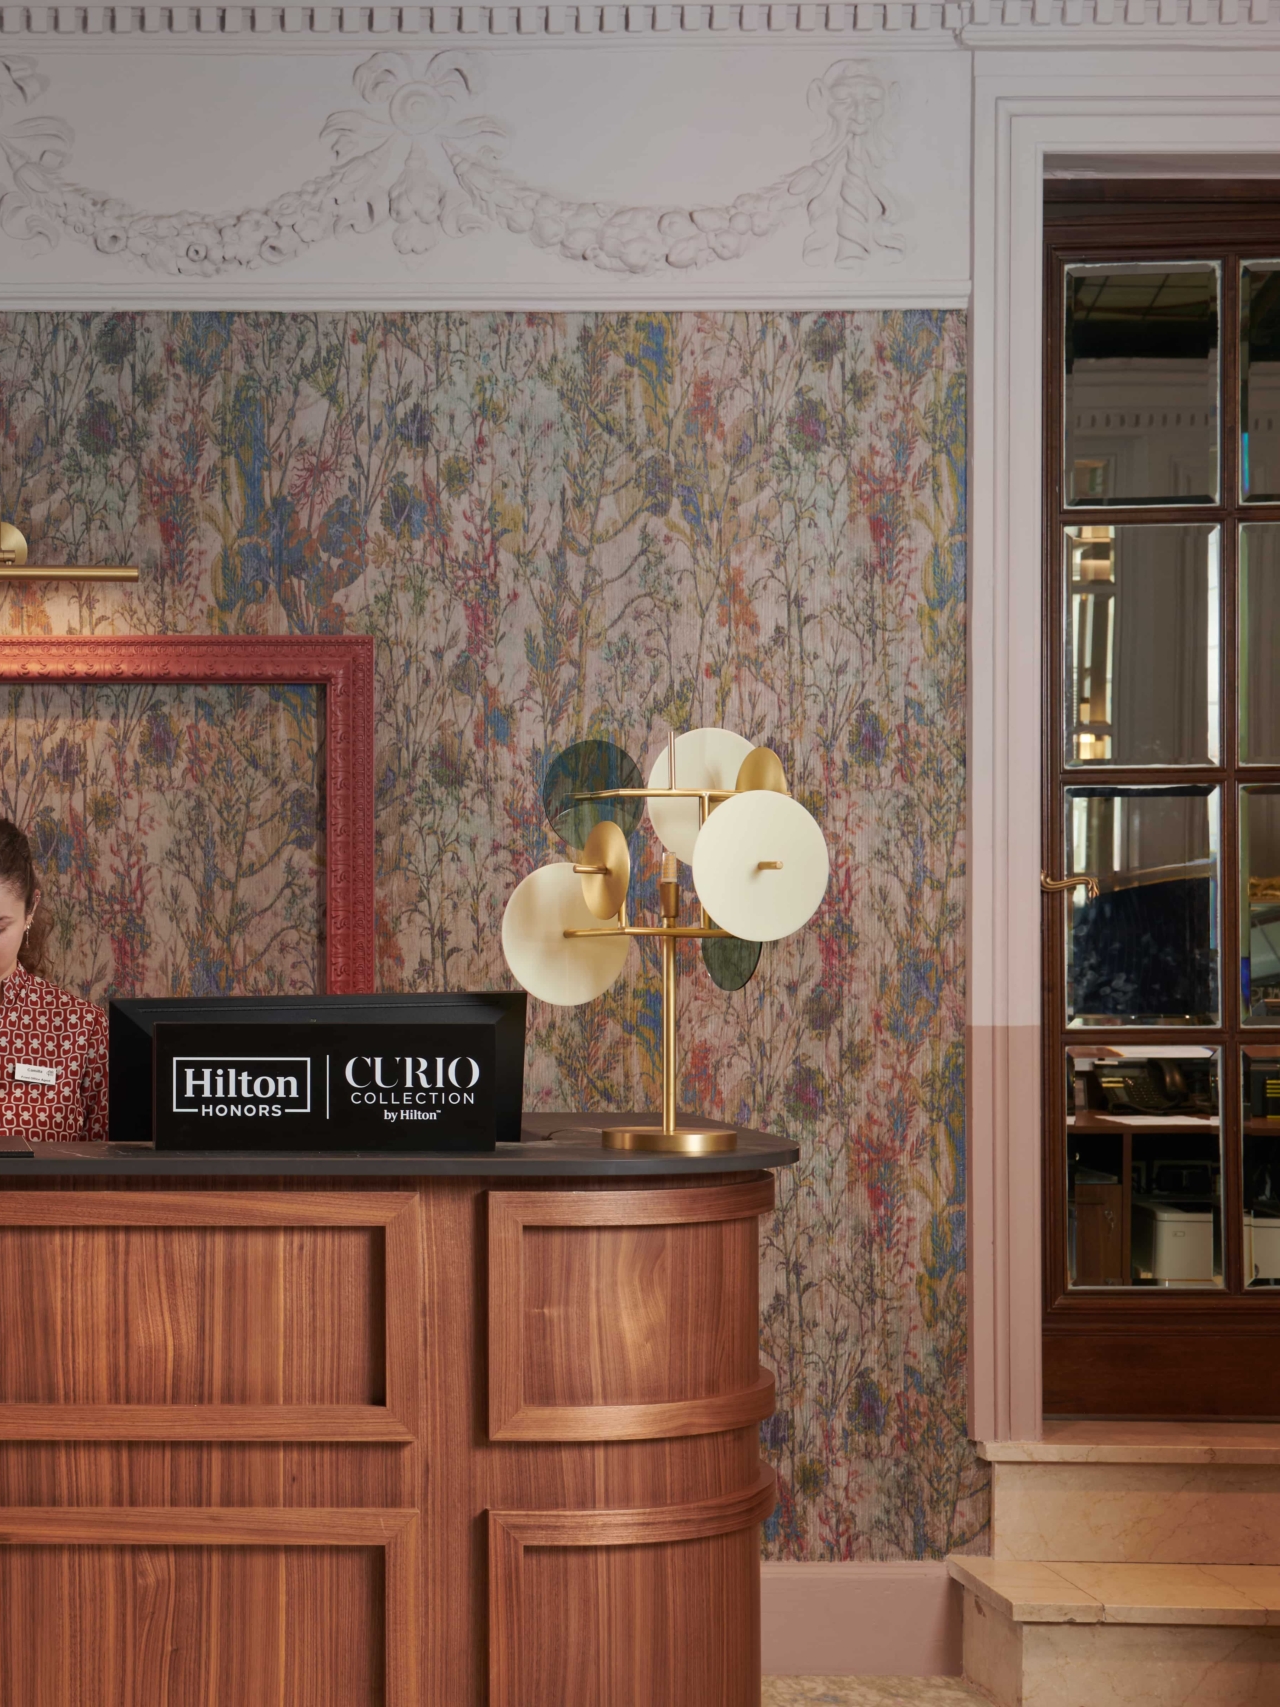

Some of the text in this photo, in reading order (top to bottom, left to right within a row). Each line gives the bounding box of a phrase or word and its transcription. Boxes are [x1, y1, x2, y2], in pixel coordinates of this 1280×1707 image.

[345, 1057, 480, 1089] CURIO
[184, 1068, 300, 1098] Hilton
[351, 1092, 475, 1105] COLLECTION
[202, 1104, 282, 1117] HONORS
[384, 1109, 398, 1122] by
